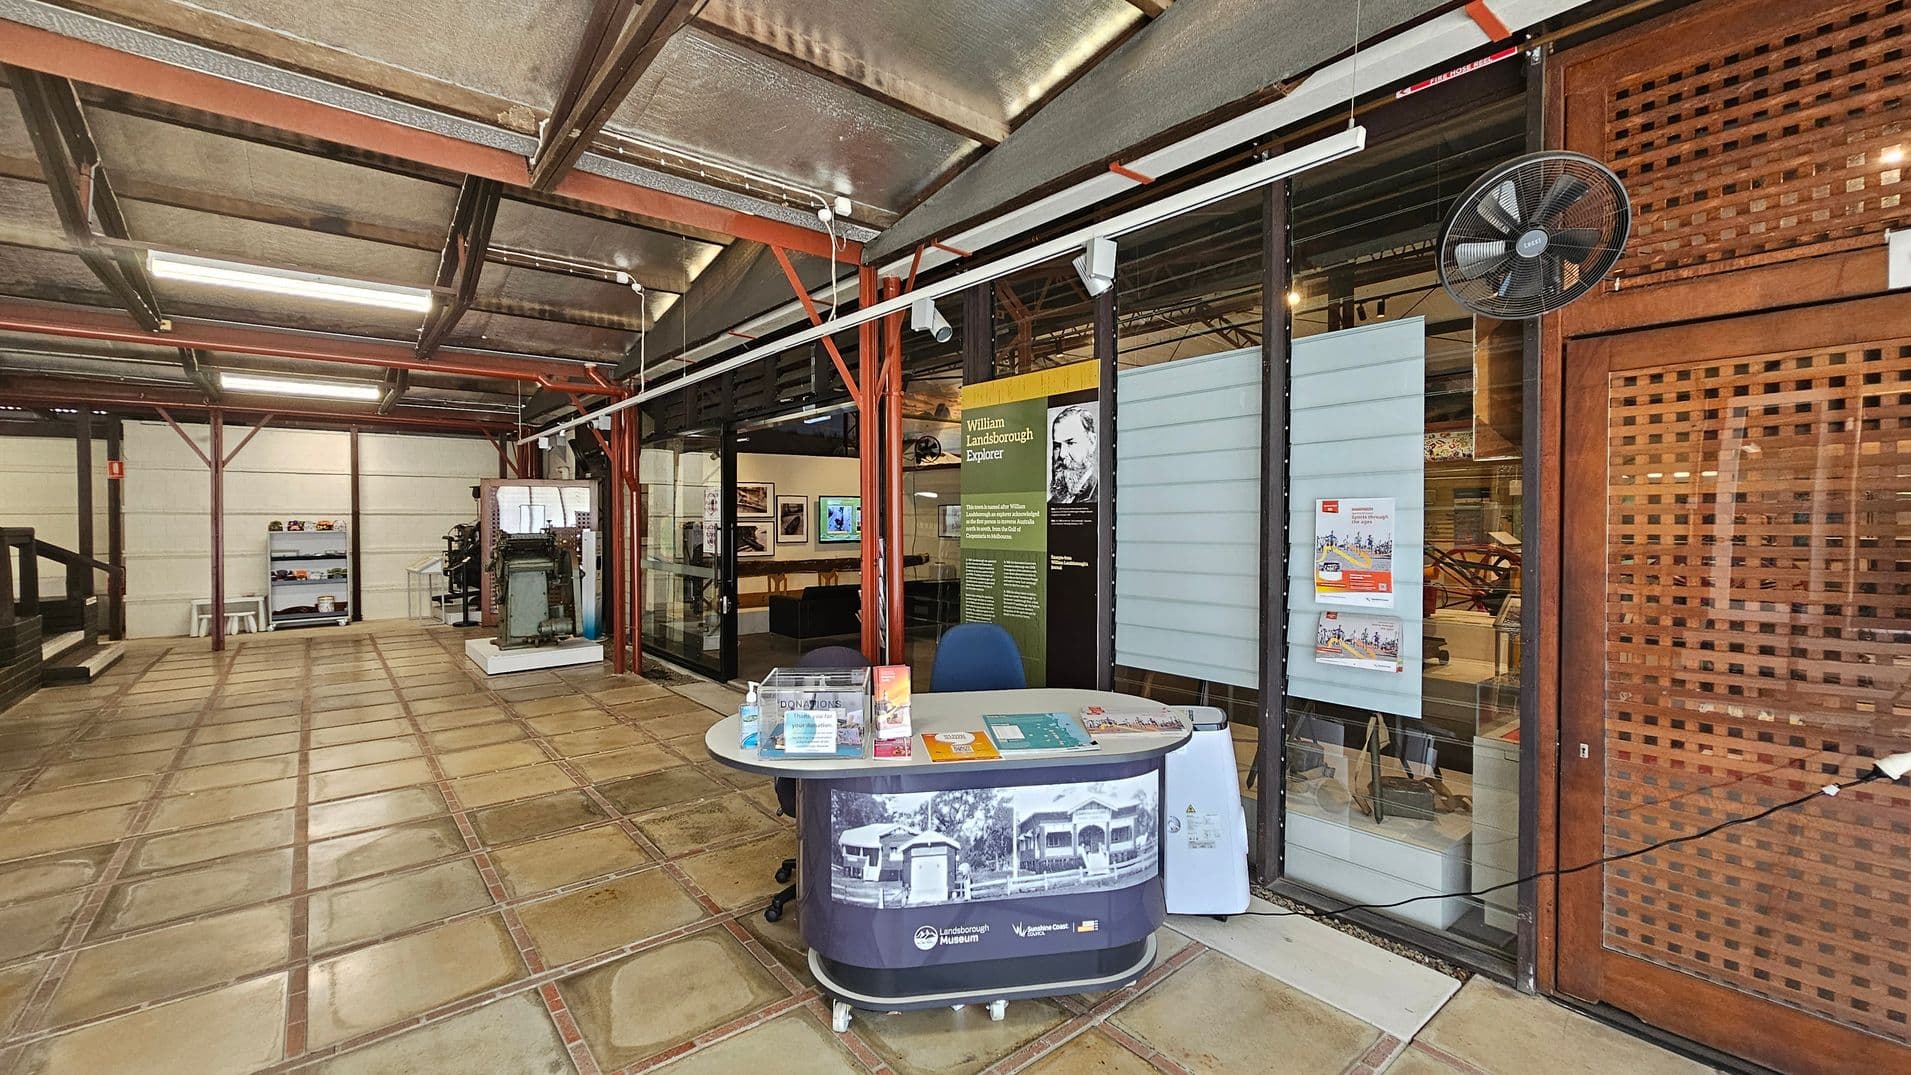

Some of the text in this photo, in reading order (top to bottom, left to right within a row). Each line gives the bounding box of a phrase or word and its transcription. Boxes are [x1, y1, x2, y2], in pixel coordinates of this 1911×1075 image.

[1430, 56, 1493, 84] FIRE HOSE REEL
[966, 417, 1005, 432] William
[966, 427, 1034, 447] Landsborough
[966, 447, 1004, 464] Explorer
[780, 700, 842, 709] DONATIONS
[940, 923, 990, 936] Landsborough
[1027, 924, 1051, 933] Sunshine
[1052, 922, 1069, 931] Coast
[940, 934, 979, 945] Museum
